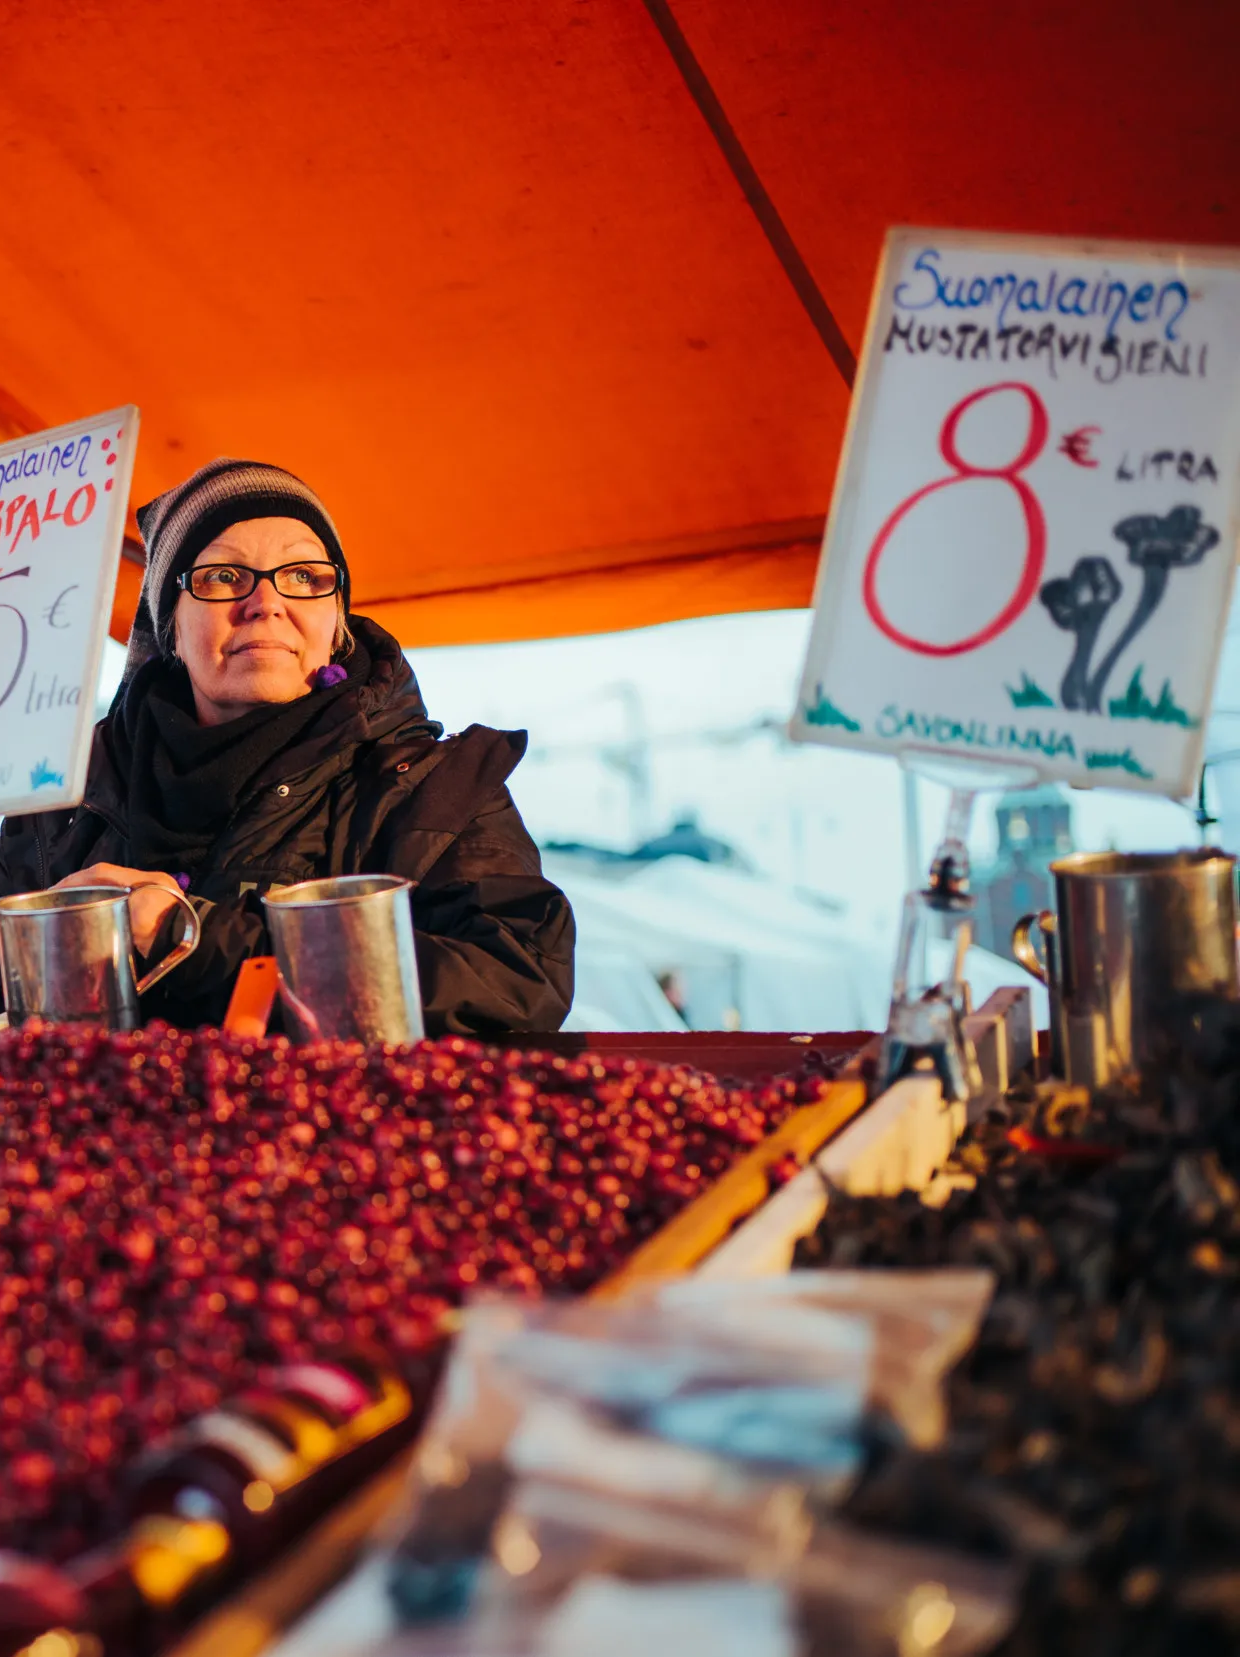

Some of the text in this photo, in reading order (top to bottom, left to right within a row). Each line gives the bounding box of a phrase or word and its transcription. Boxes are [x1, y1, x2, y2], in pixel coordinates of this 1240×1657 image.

[892, 248, 1190, 341] Suomalainen
[862, 381, 1219, 658] 8 € LITRA
[41, 584, 79, 629] €
[25, 671, 82, 714] litra
